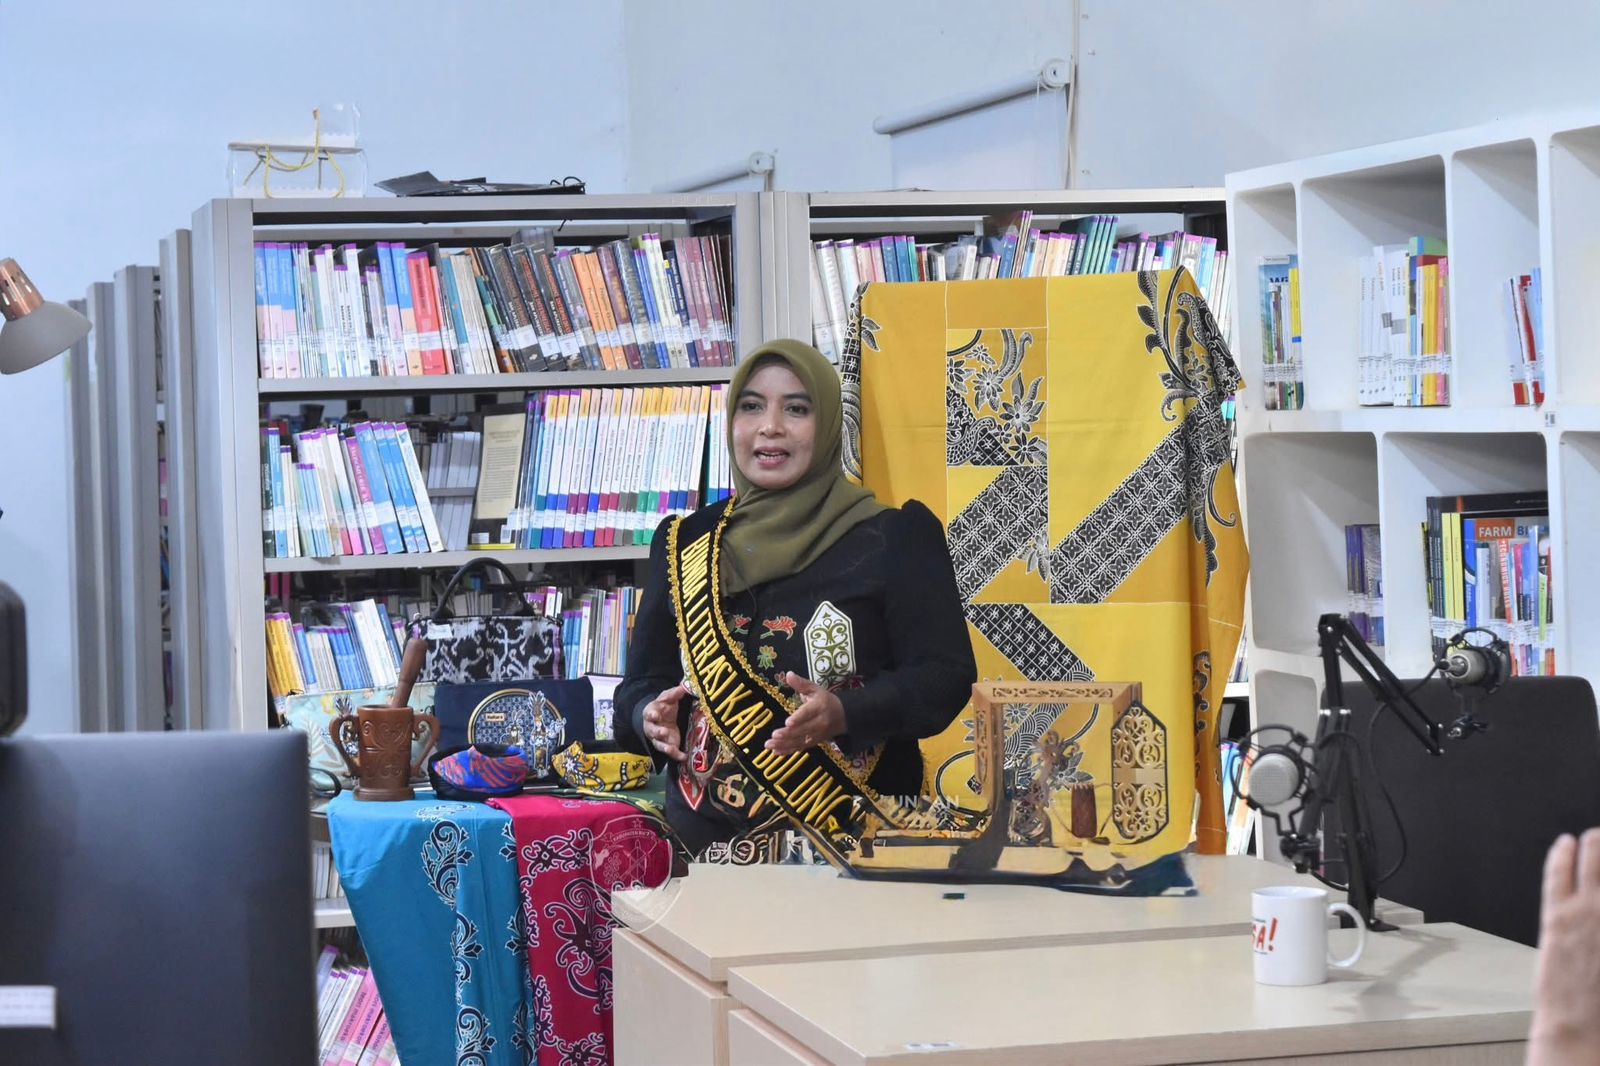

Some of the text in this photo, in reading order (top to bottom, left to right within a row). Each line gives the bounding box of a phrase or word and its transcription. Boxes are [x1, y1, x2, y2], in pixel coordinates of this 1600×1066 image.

[1478, 526, 1512, 538] FARM
[681, 531, 711, 608] BUNDA
[685, 594, 739, 702] LITERASI
[714, 682, 774, 754] KAB.
